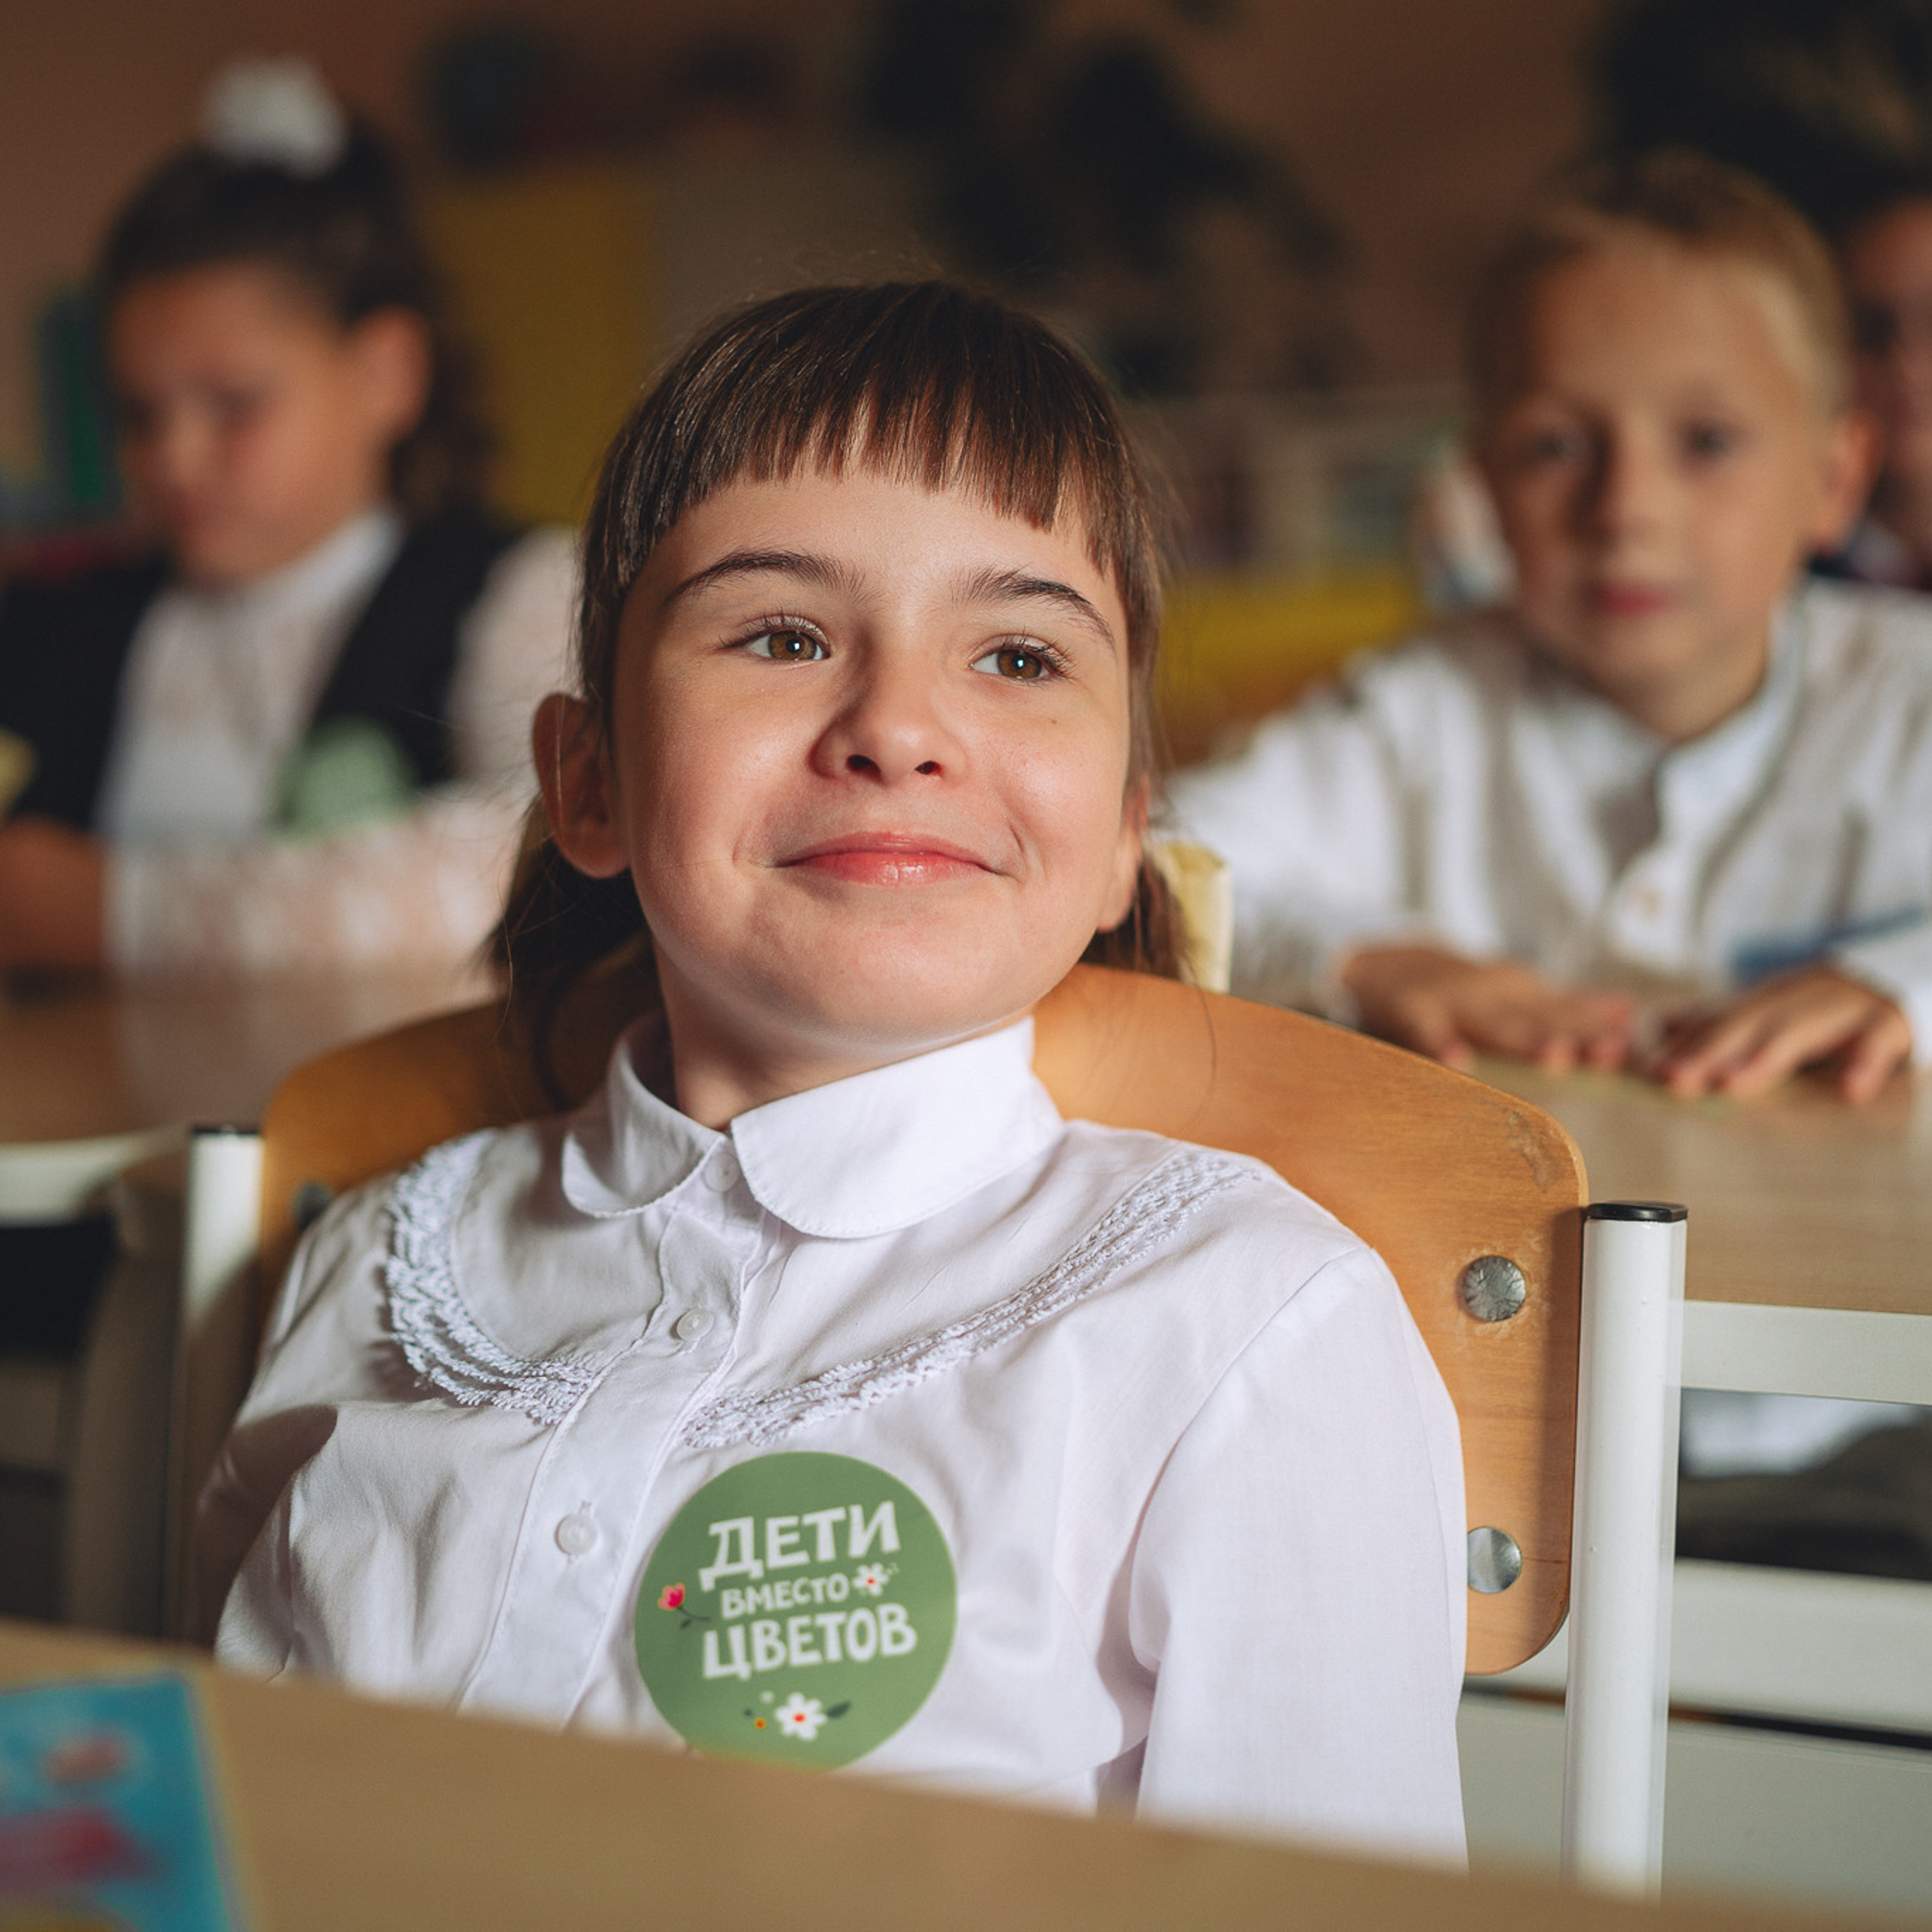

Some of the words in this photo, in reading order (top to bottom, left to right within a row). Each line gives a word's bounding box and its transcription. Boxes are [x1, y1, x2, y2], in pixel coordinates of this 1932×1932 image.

[699, 1501, 901, 1592] ДЕТИ
[720, 1573, 850, 1620] ВМЕСТО
[703, 1603, 918, 1681] ЦВЕТОВ
